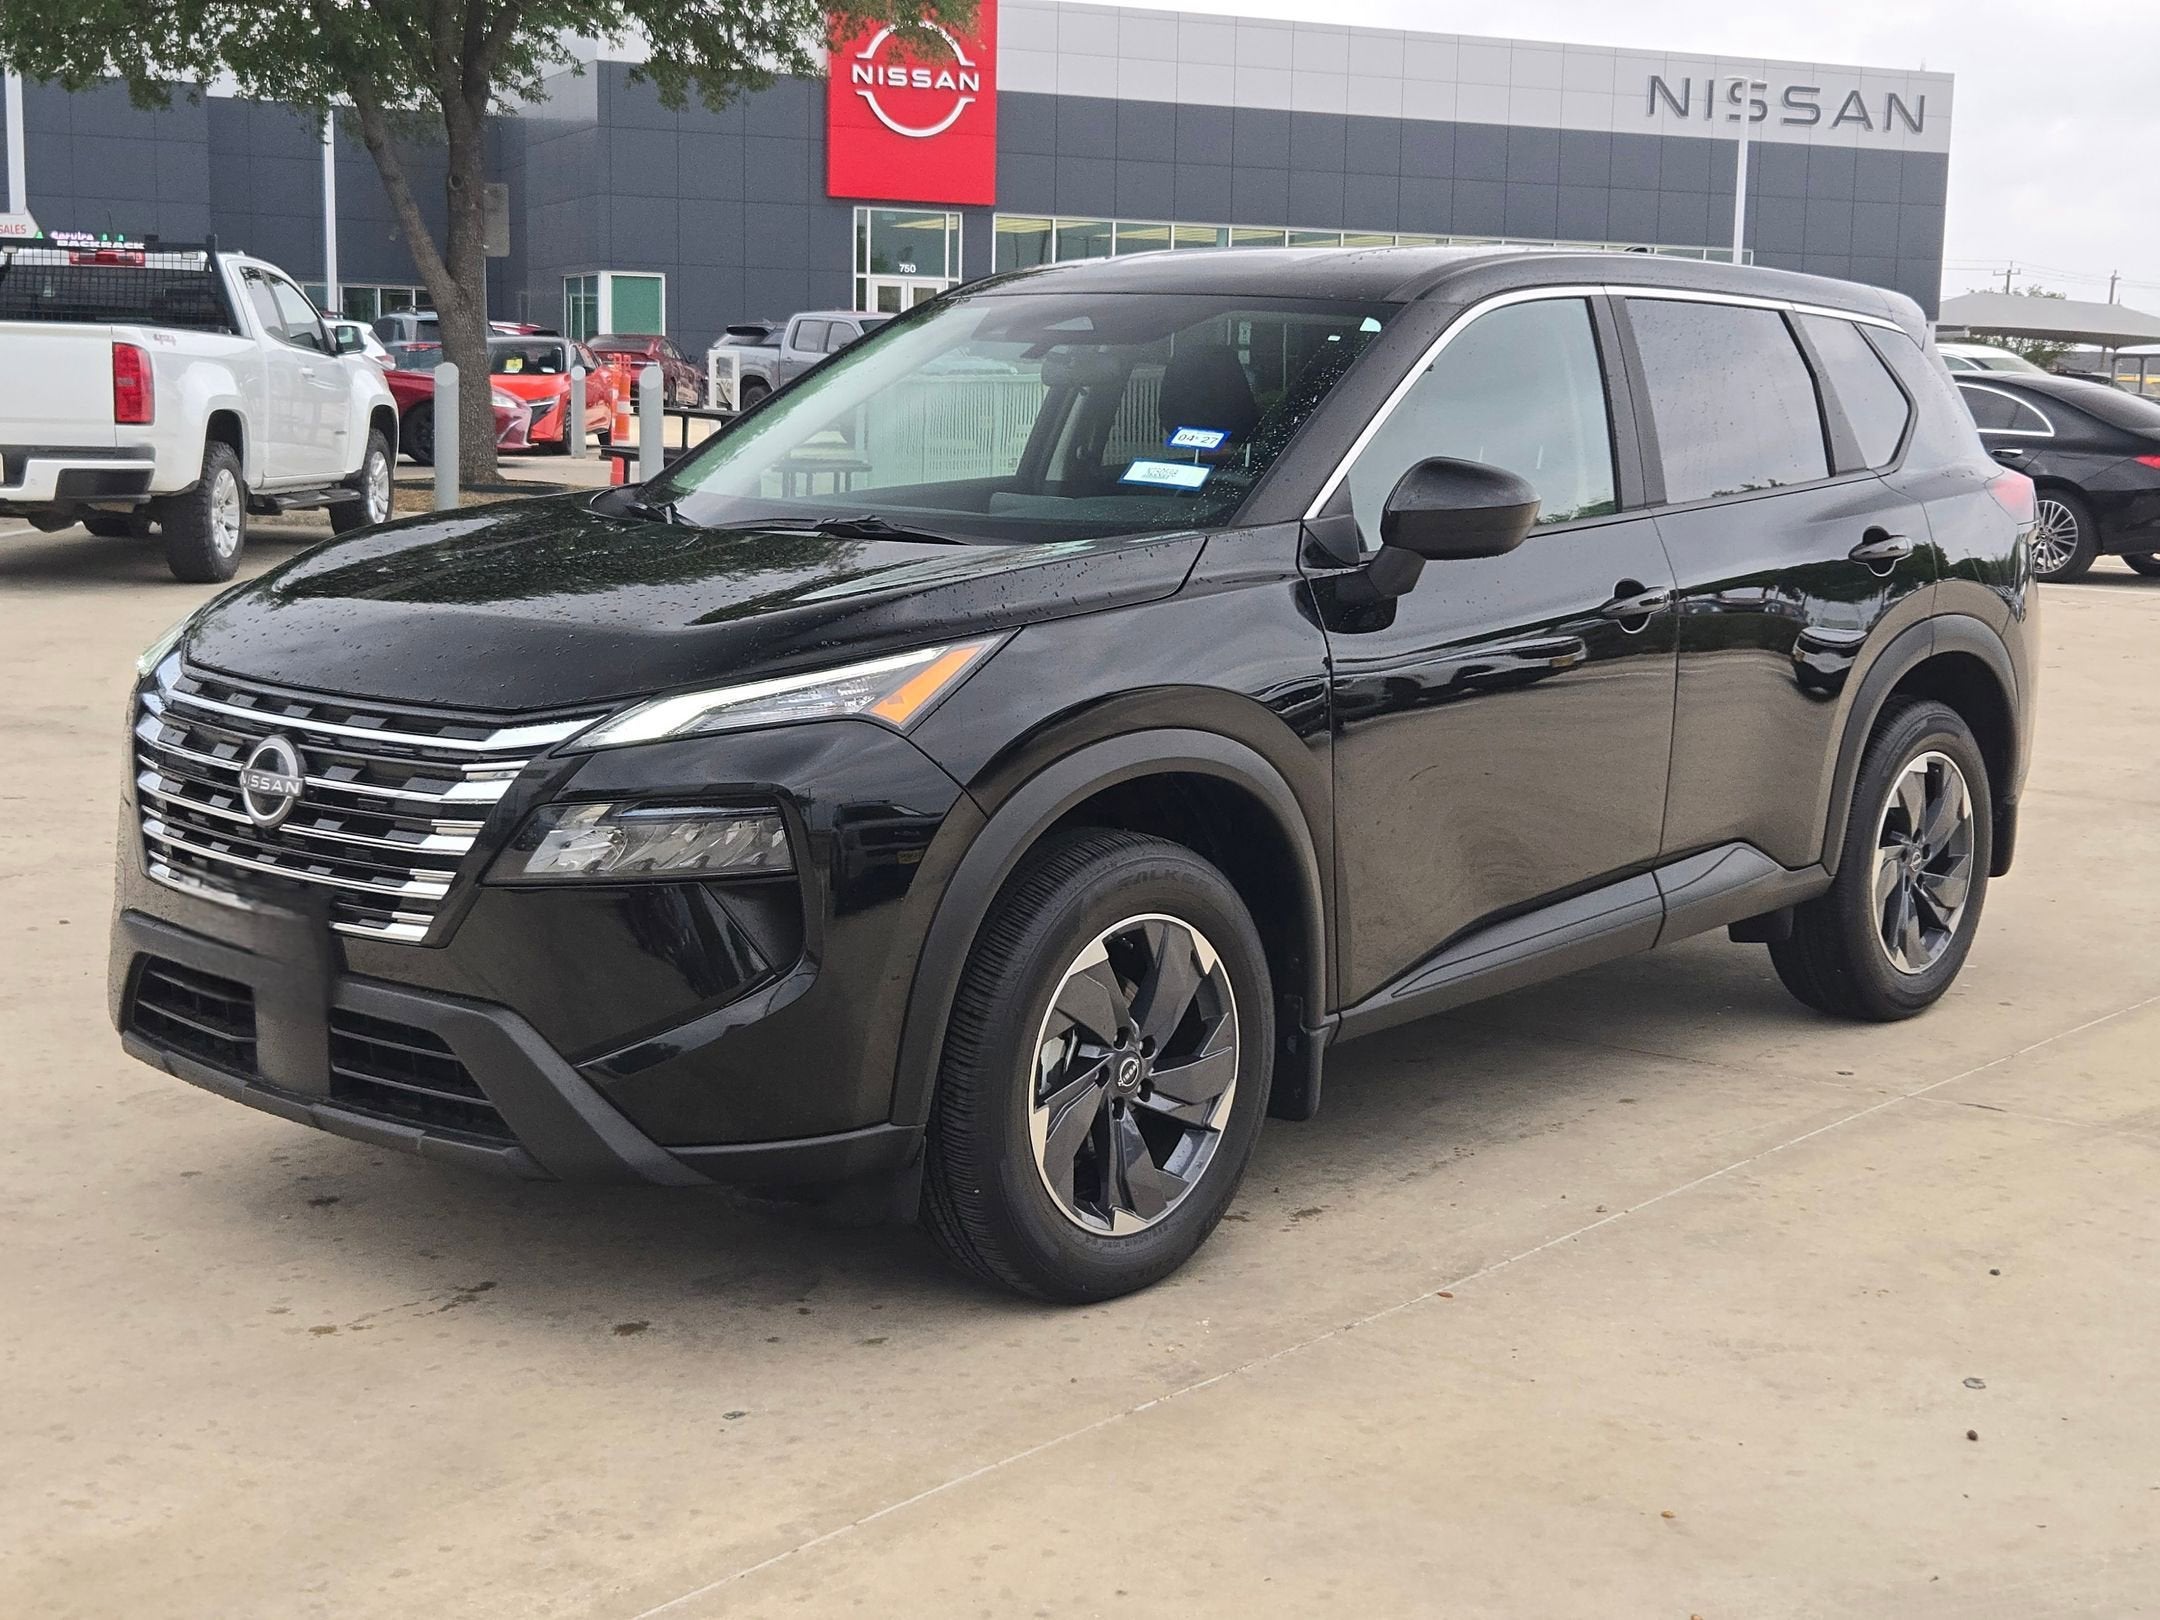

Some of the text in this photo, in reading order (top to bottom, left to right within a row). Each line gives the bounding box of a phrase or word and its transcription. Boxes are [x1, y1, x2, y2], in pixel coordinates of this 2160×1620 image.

[851, 63, 980, 92] NISSAN
[1648, 75, 1925, 135] NISSAN
[57, 240, 145, 250] BACKRACK
[899, 264, 916, 273] 750
[240, 770, 300, 794] NISSAN
